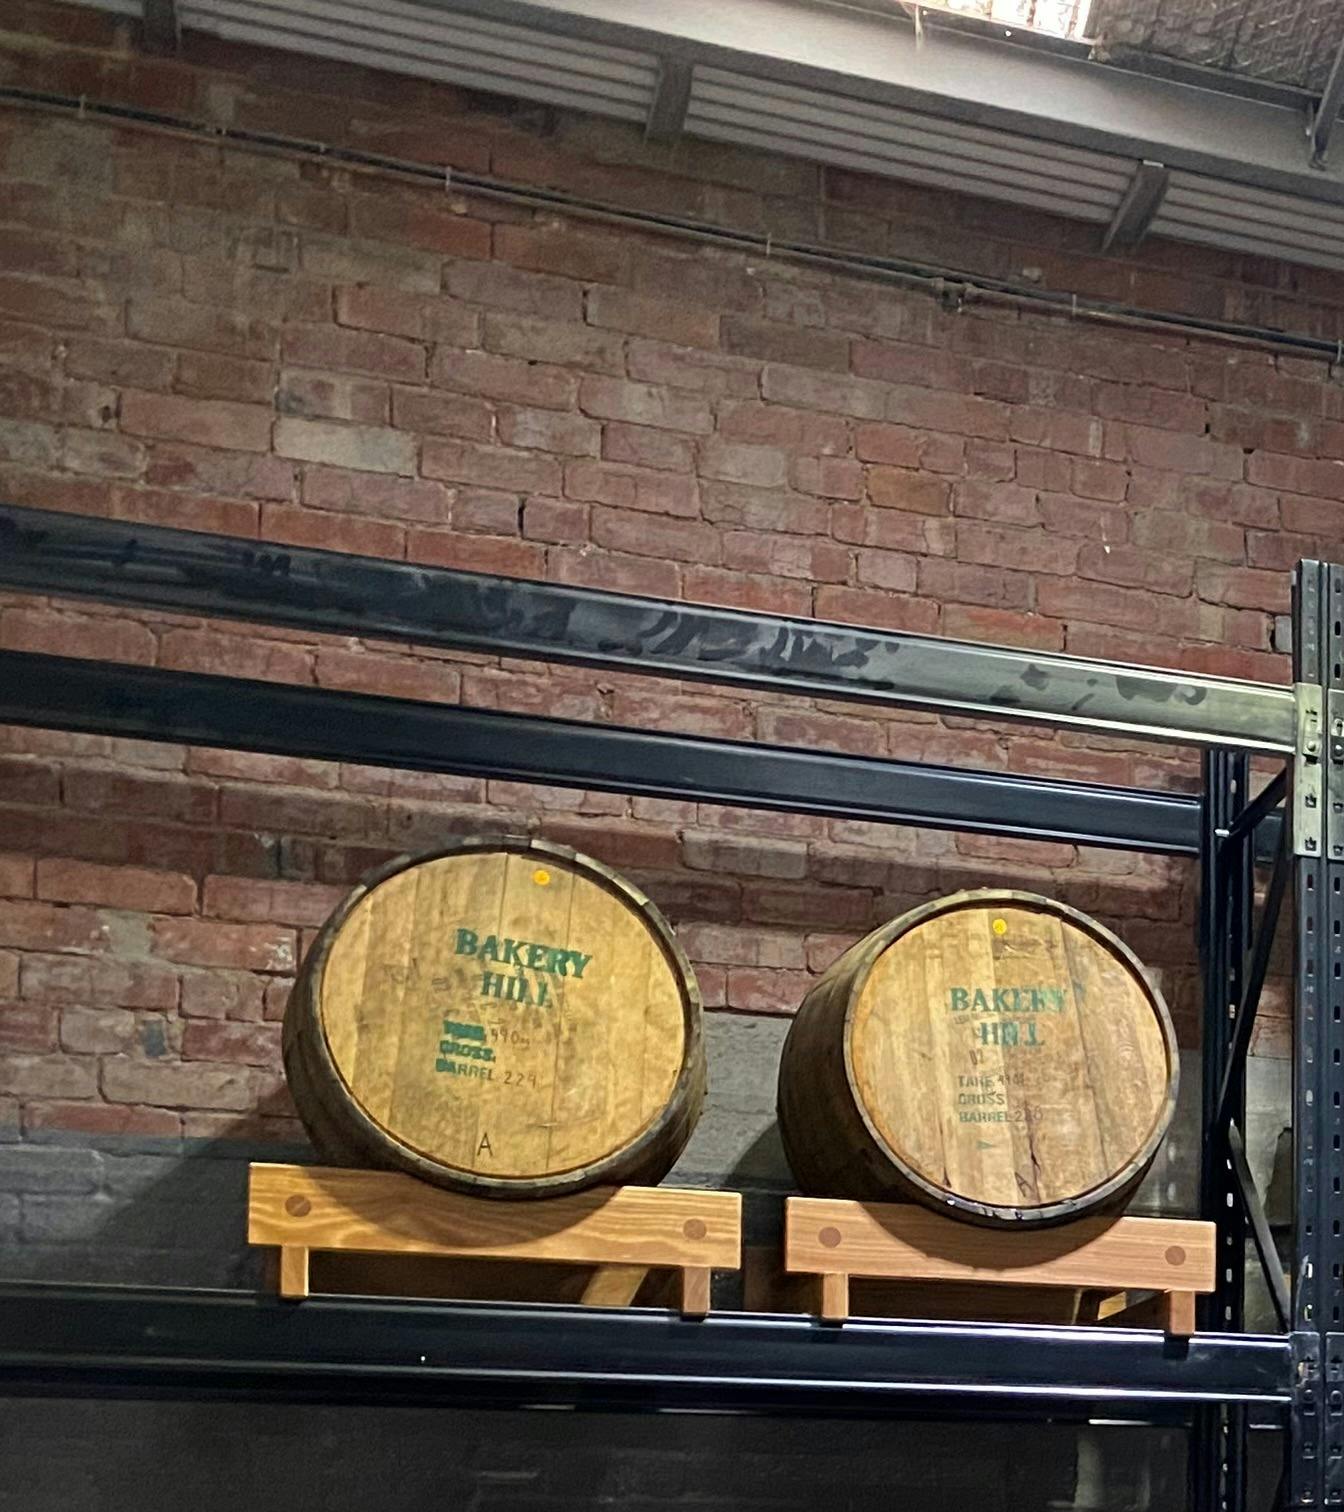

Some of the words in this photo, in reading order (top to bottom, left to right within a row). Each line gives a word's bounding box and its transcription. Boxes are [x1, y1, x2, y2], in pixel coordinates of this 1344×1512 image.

[454, 928, 593, 979] BAKERY
[480, 971, 554, 1009] HILL
[476, 1131, 494, 1157] A
